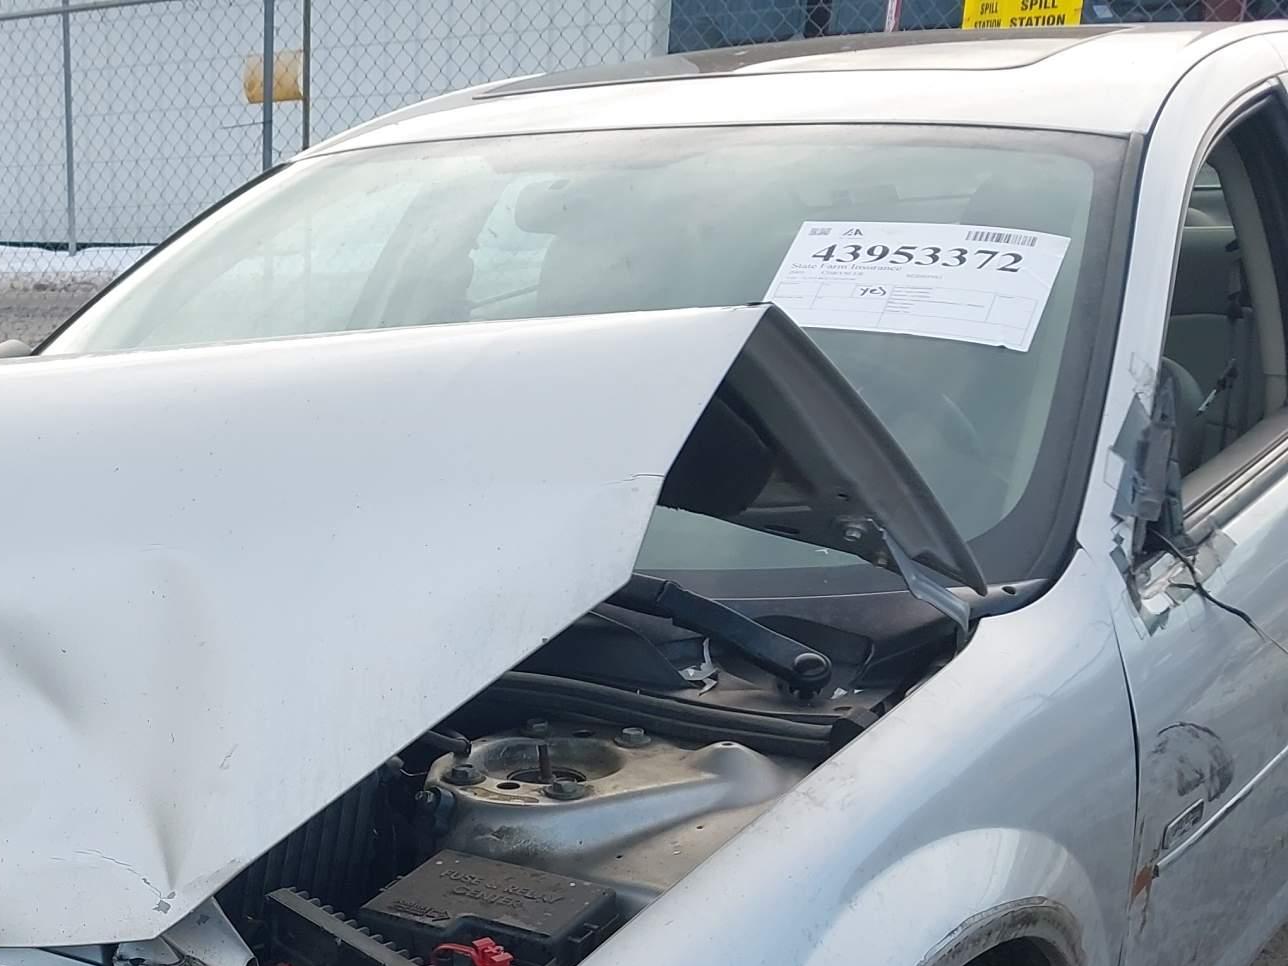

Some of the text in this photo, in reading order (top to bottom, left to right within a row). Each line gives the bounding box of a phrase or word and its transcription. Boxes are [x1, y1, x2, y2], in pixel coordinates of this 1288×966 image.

[980, 2, 998, 15] SPILL
[1020, 0, 1058, 11] SPILL
[974, 19, 1001, 29] STATION
[1009, 14, 1066, 28] STATION
[811, 243, 1024, 273] 43953372
[791, 262, 818, 270] State
[850, 263, 903, 272] Insurance
[440, 869, 483, 886] FUSE
[503, 886, 564, 905] RELAY
[451, 886, 521, 909] CENTER
